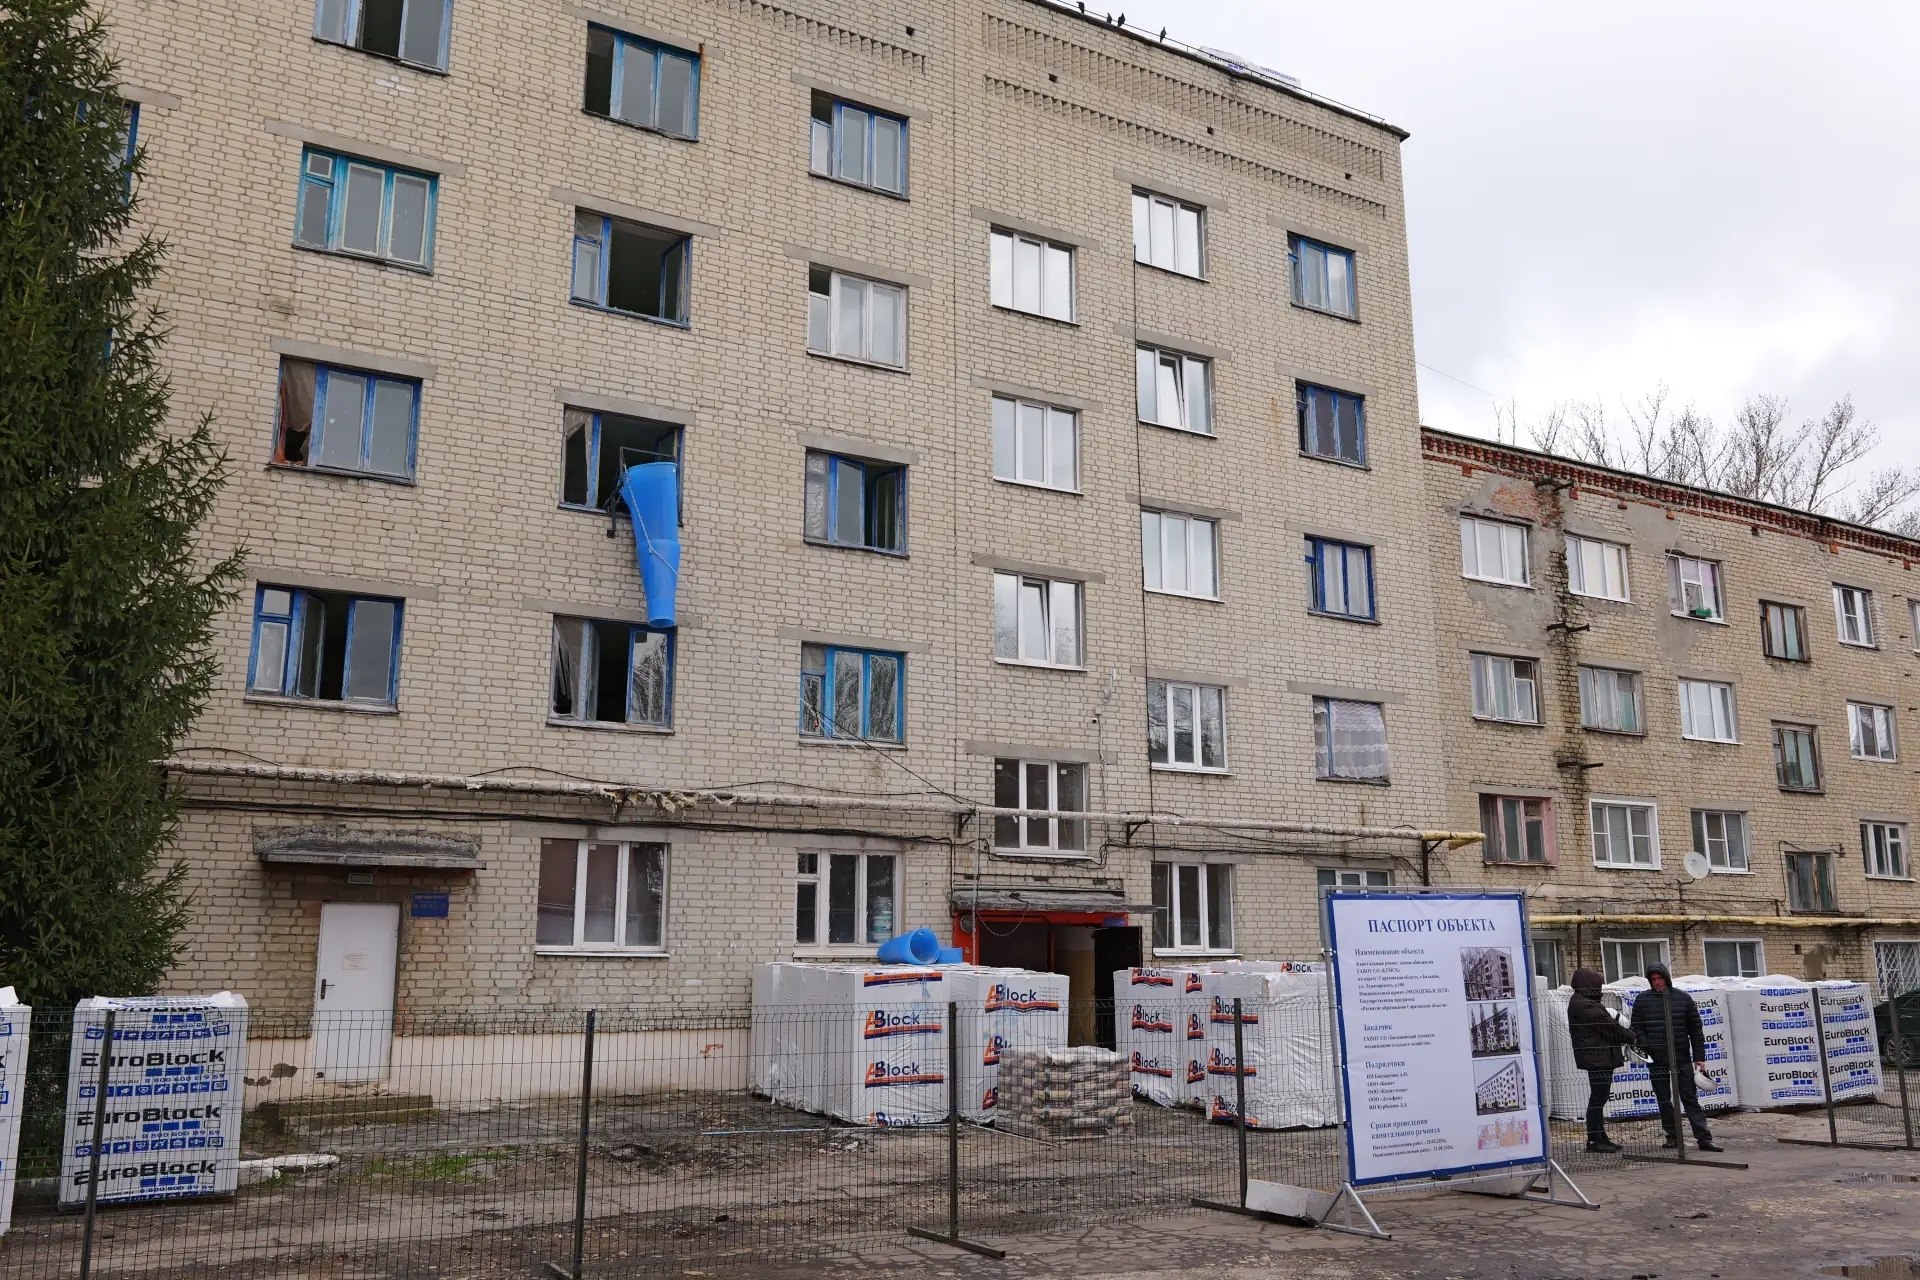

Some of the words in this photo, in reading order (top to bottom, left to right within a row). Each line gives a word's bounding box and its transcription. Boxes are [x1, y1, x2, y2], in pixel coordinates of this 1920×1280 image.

[1368, 919, 1433, 932] ПАСПОРТ
[1437, 918, 1496, 932] ОБЪЕКТА
[1760, 1001, 1809, 1012] EuroBlock
[1825, 1027, 1870, 1040] EuroBlock
[1764, 1035, 1815, 1046] EuroBlock
[1366, 1061, 1405, 1069] Подрядчики
[1829, 1060, 1874, 1075] EuroBlock
[1768, 1070, 1818, 1081] EuroBlock
[1609, 1090, 1656, 1102] EuroBloc
[1371, 1121, 1392, 1130] Сроки
[1393, 1119, 1427, 1129] проведения
[1372, 1131, 1414, 1140] капитального
[1416, 1128, 1440, 1136] ремонта
